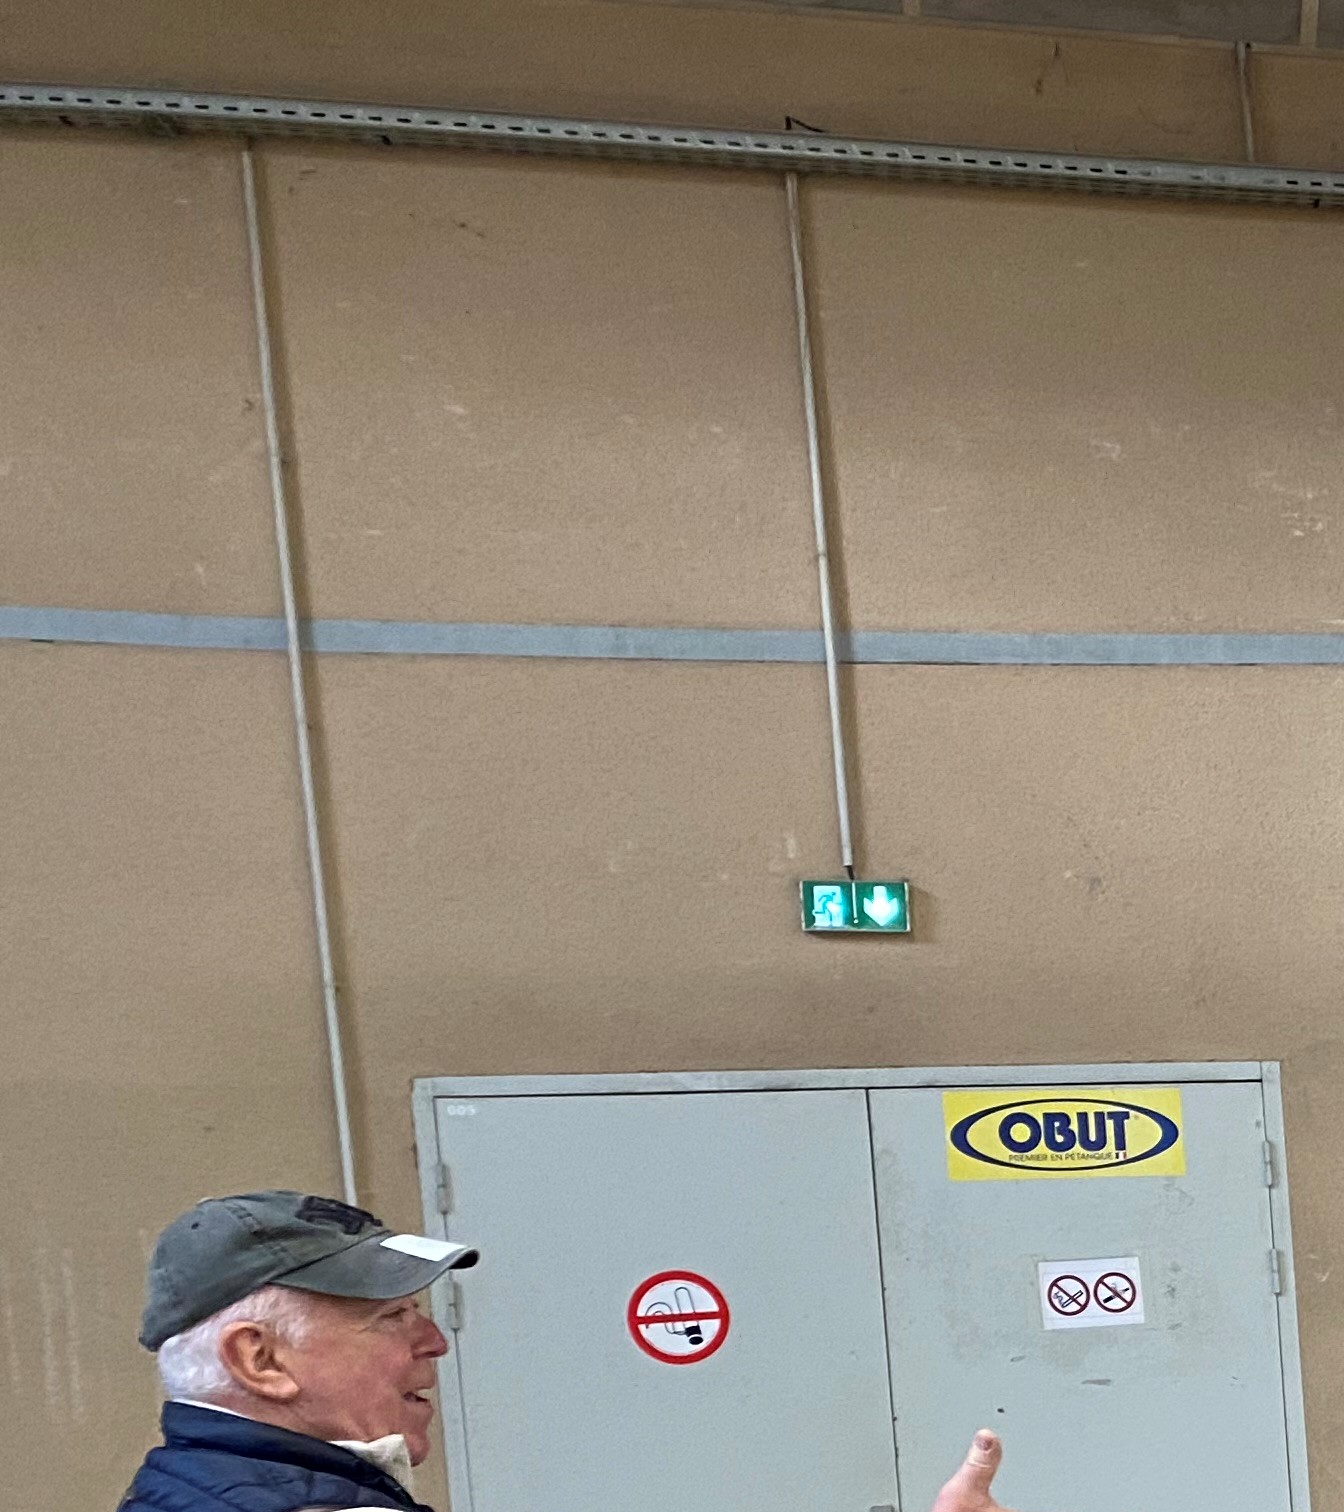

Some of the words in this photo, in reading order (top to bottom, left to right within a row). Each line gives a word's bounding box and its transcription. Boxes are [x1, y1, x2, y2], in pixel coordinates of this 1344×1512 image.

[998, 1111, 1130, 1154] OBUT
[1008, 1153, 1048, 1162] PREMIER
[1050, 1152, 1063, 1161] EN
